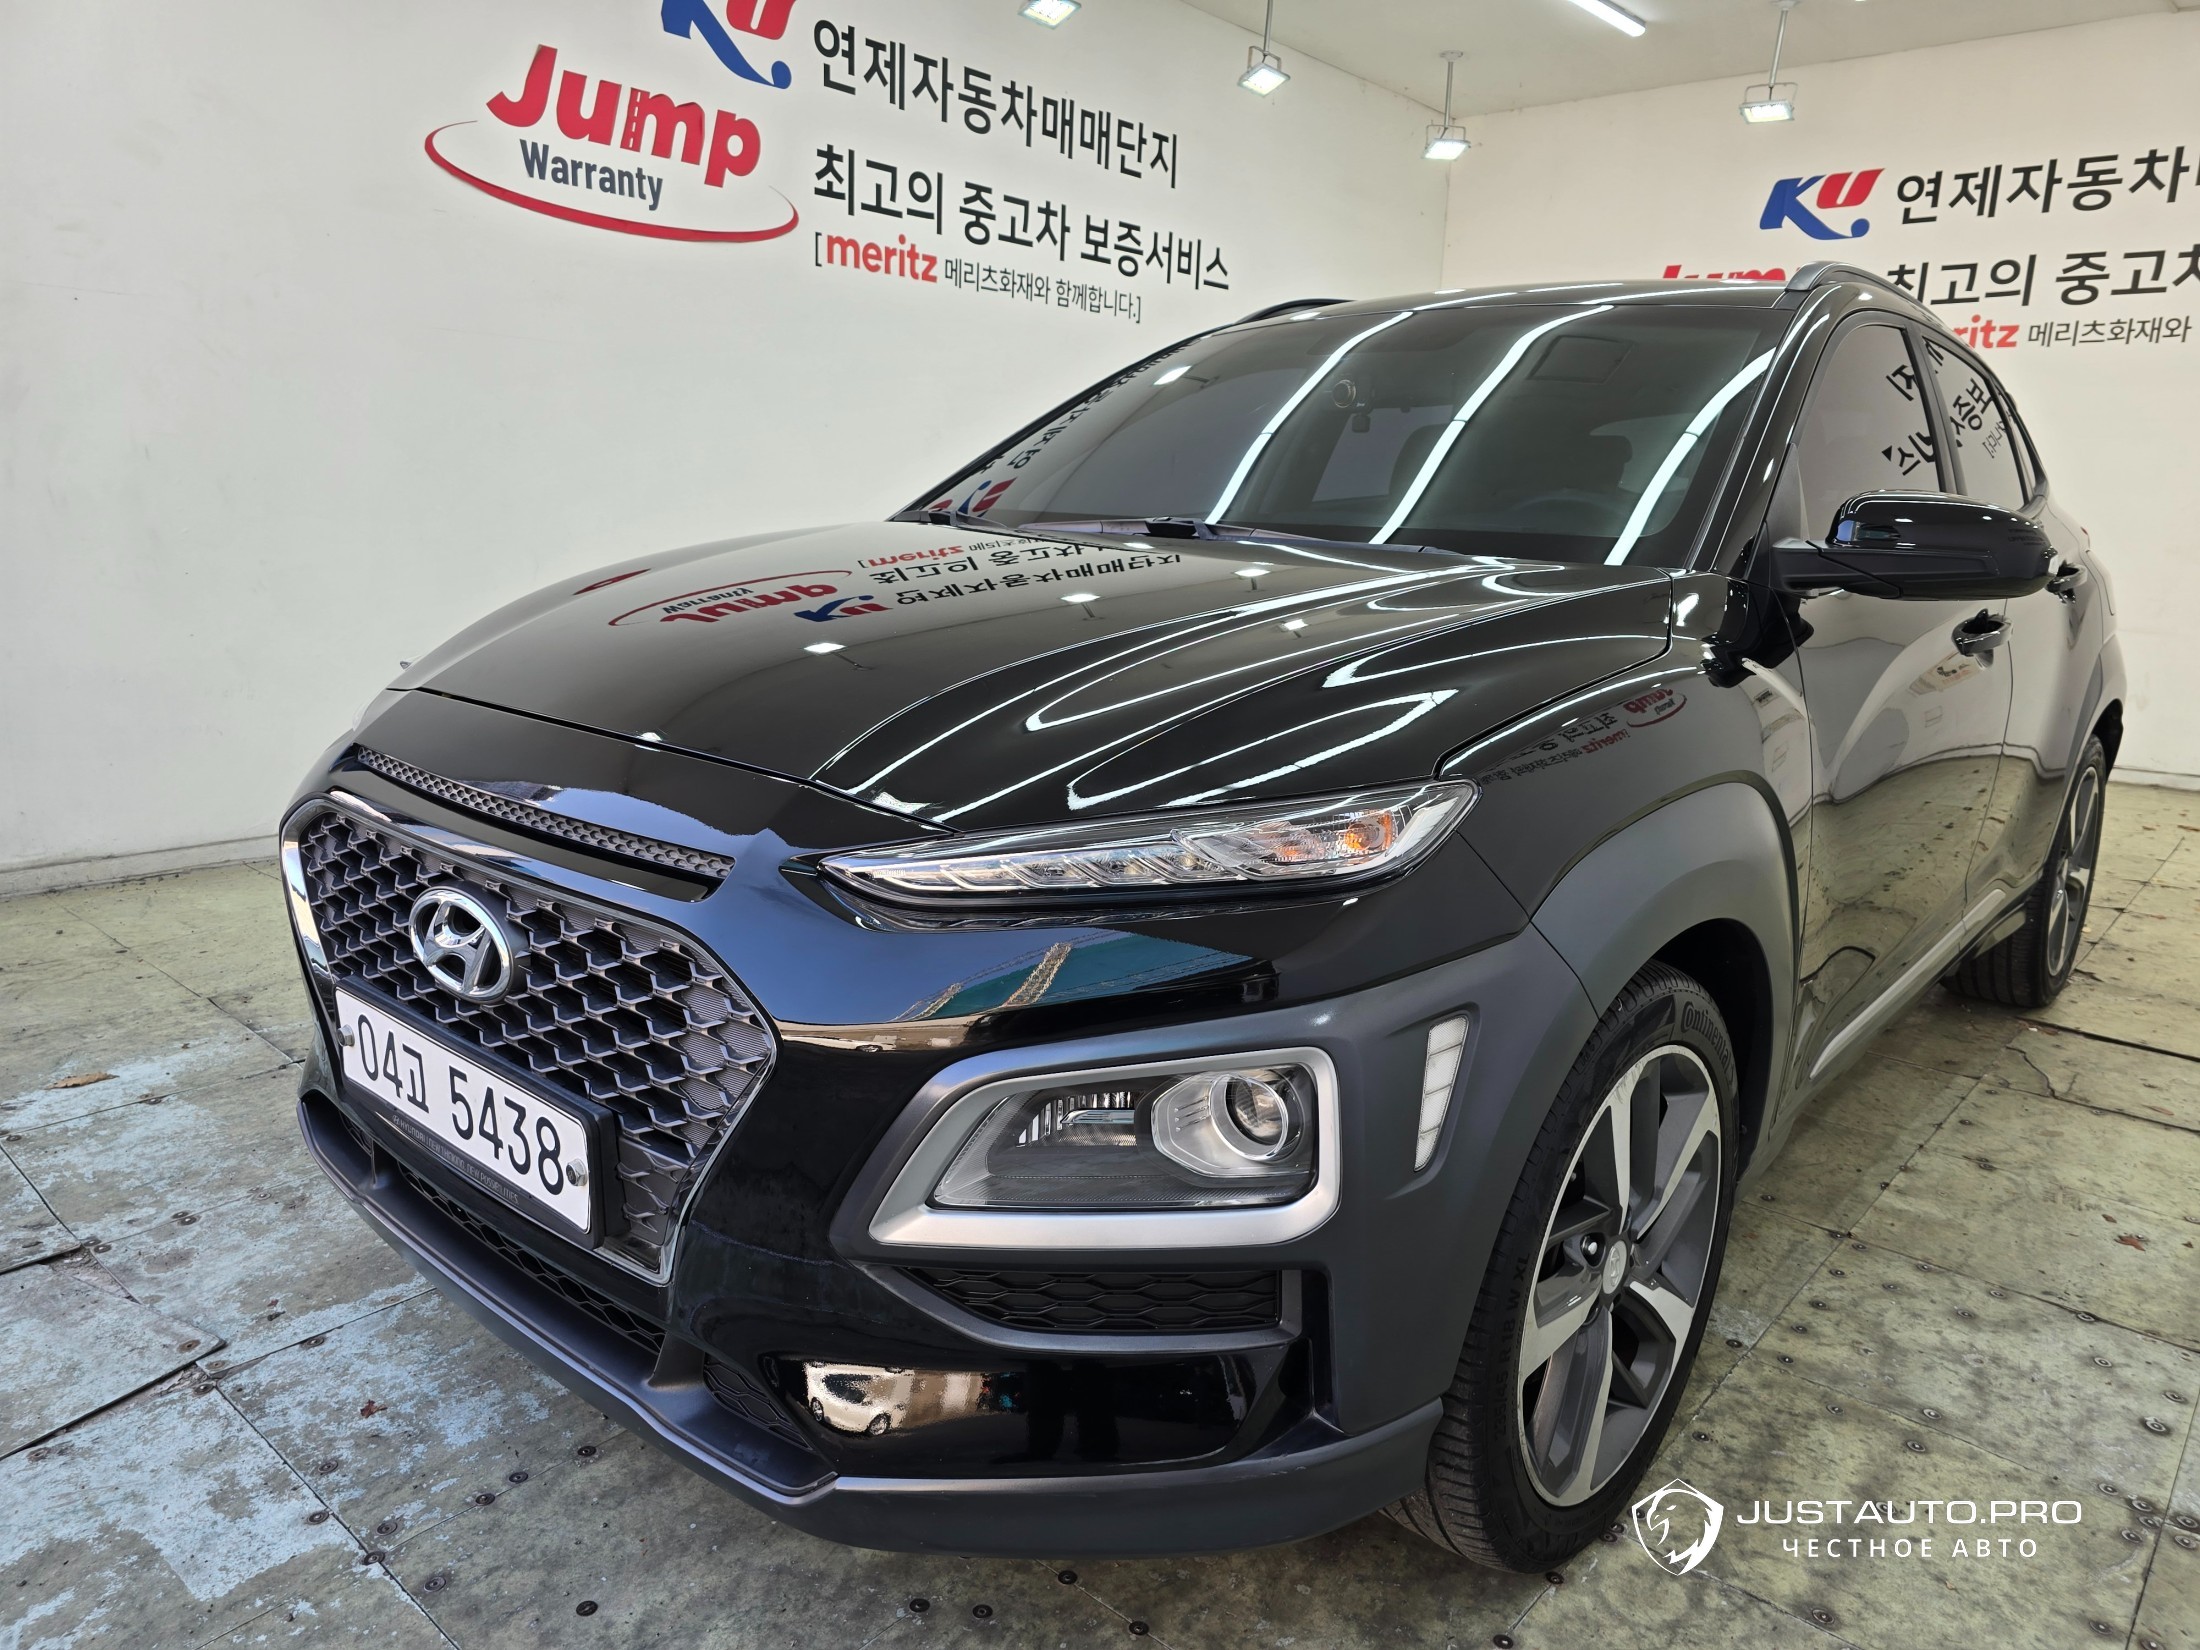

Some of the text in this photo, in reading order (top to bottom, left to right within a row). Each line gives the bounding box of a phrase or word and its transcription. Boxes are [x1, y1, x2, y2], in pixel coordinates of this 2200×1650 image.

[486, 43, 761, 188] Jump
[813, 19, 1178, 189] 연제자동차매매단지
[519, 138, 663, 211] Warranty
[1898, 145, 2200, 225] 연제자동차
[813, 143, 1230, 291] 최고의 중고차 보증서비스
[944, 258, 1051, 304] 메리츠화재와
[2028, 315, 2192, 348] 메리츠화재와
[1681, 1001, 1731, 1074] Continental
[357, 1013, 564, 1196] 04고 5438
